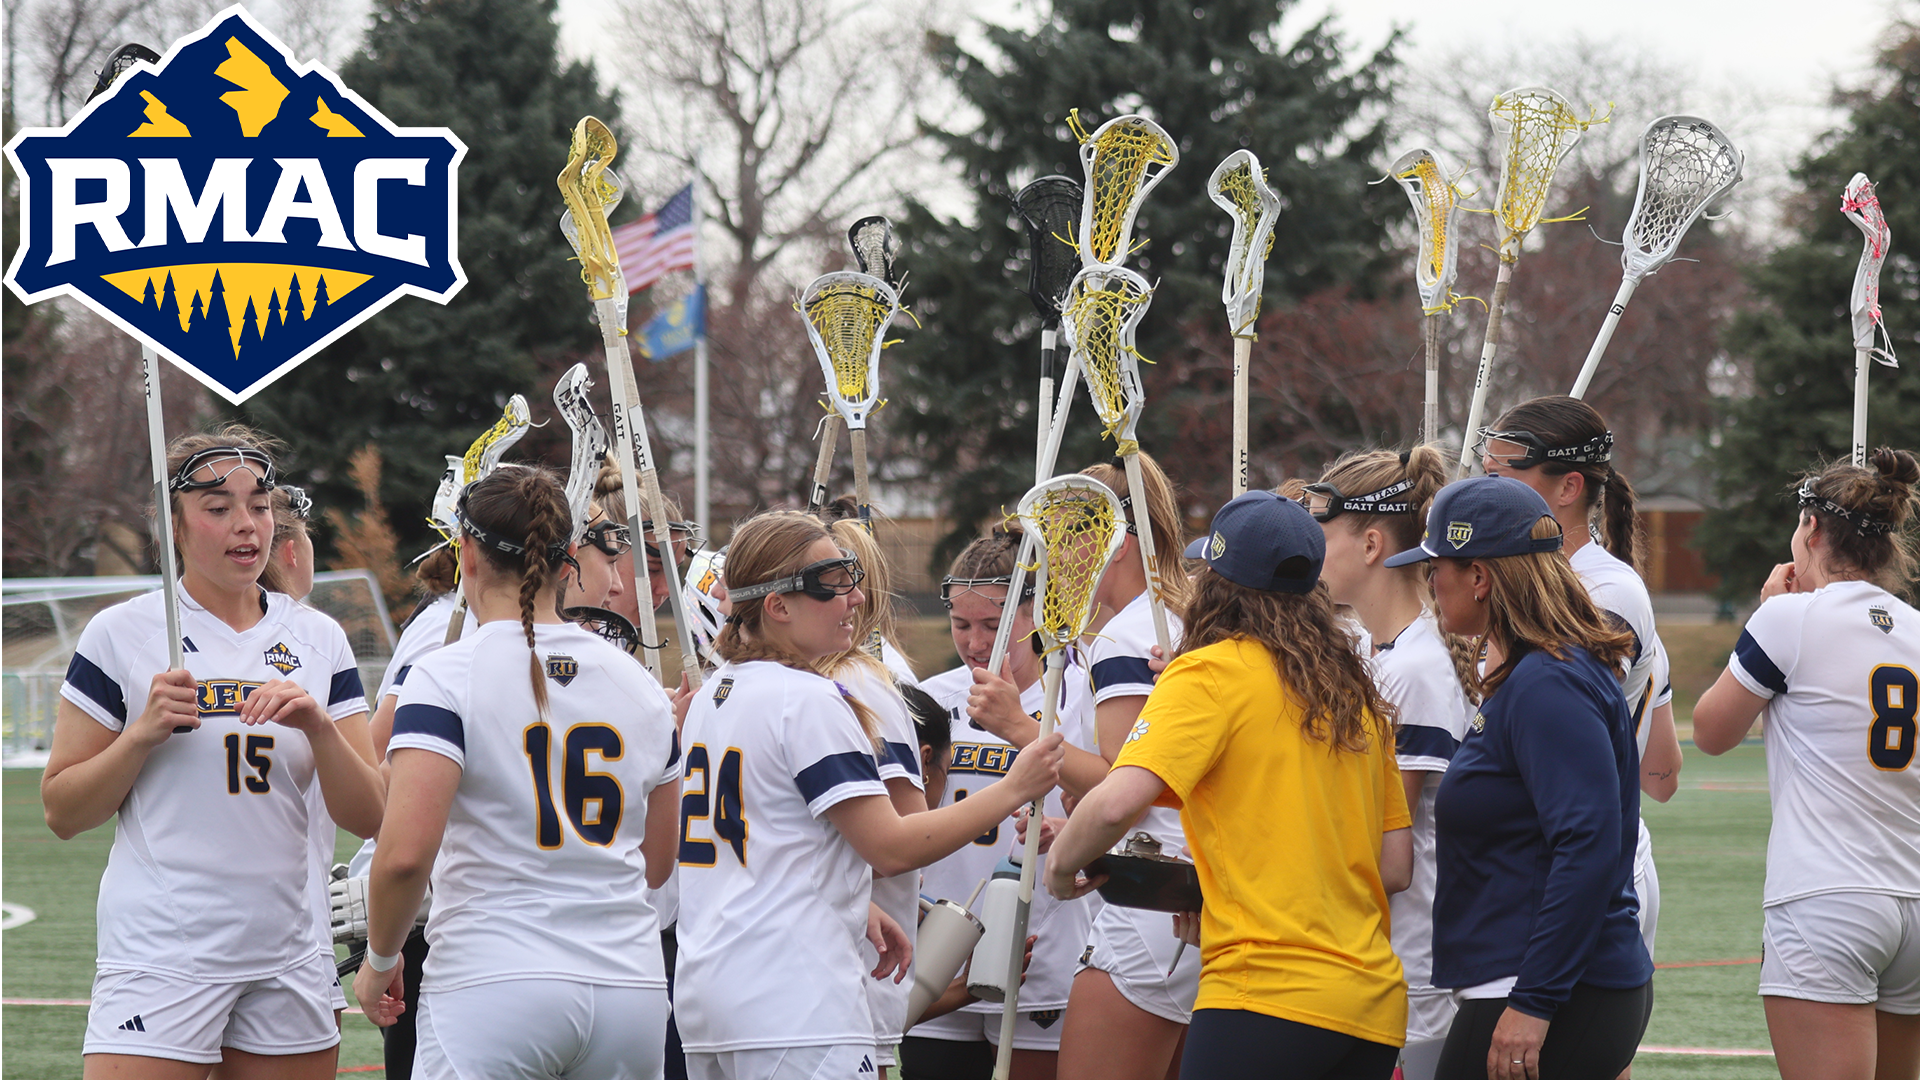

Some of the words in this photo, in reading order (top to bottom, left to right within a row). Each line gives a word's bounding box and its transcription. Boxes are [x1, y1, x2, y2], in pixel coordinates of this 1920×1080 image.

[613, 403, 625, 440] GAIT
[634, 432, 647, 468] GAIT
[1547, 446, 1578, 457] GAIT
[1855, 442, 1865, 467] AIT
[1239, 449, 1247, 488] GAIT
[1343, 502, 1374, 511] GAIT
[1378, 503, 1408, 512] GAIT
[1824, 500, 1852, 520] STX
[461, 517, 488, 543] STX
[497, 540, 525, 555] ST
[1449, 528, 1471, 541] RU
[697, 570, 716, 596] R
[265, 652, 300, 668] RMAC
[548, 660, 577, 675] RU
[1867, 662, 1919, 772] 8
[224, 732, 275, 796] 15
[523, 722, 625, 850] 16
[678, 742, 749, 869] 24
